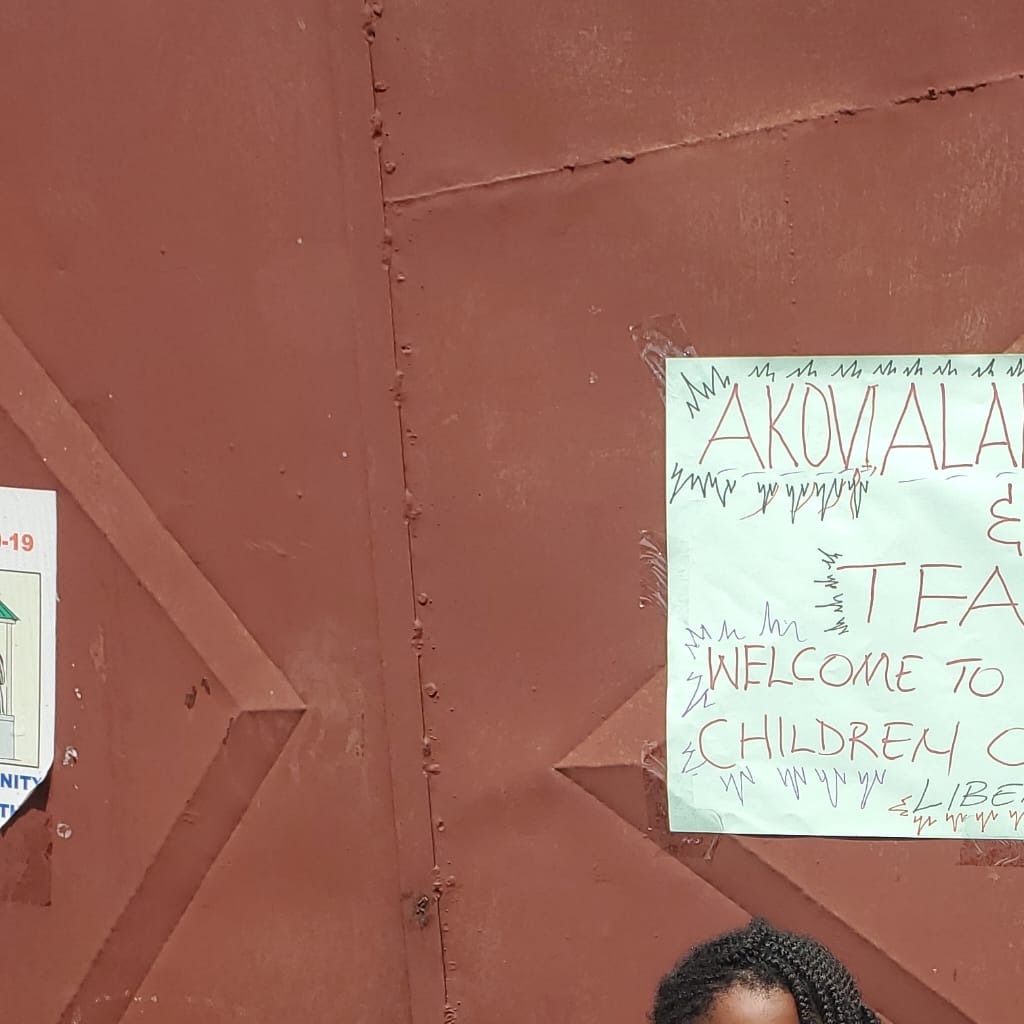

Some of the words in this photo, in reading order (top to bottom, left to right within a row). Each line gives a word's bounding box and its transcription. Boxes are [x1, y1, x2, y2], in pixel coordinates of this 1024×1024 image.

[986, 483, 1022, 557] &
[708, 644, 924, 693] WELCOME
[946, 657, 1005, 698] TO
[699, 713, 961, 776] CHILDREN
